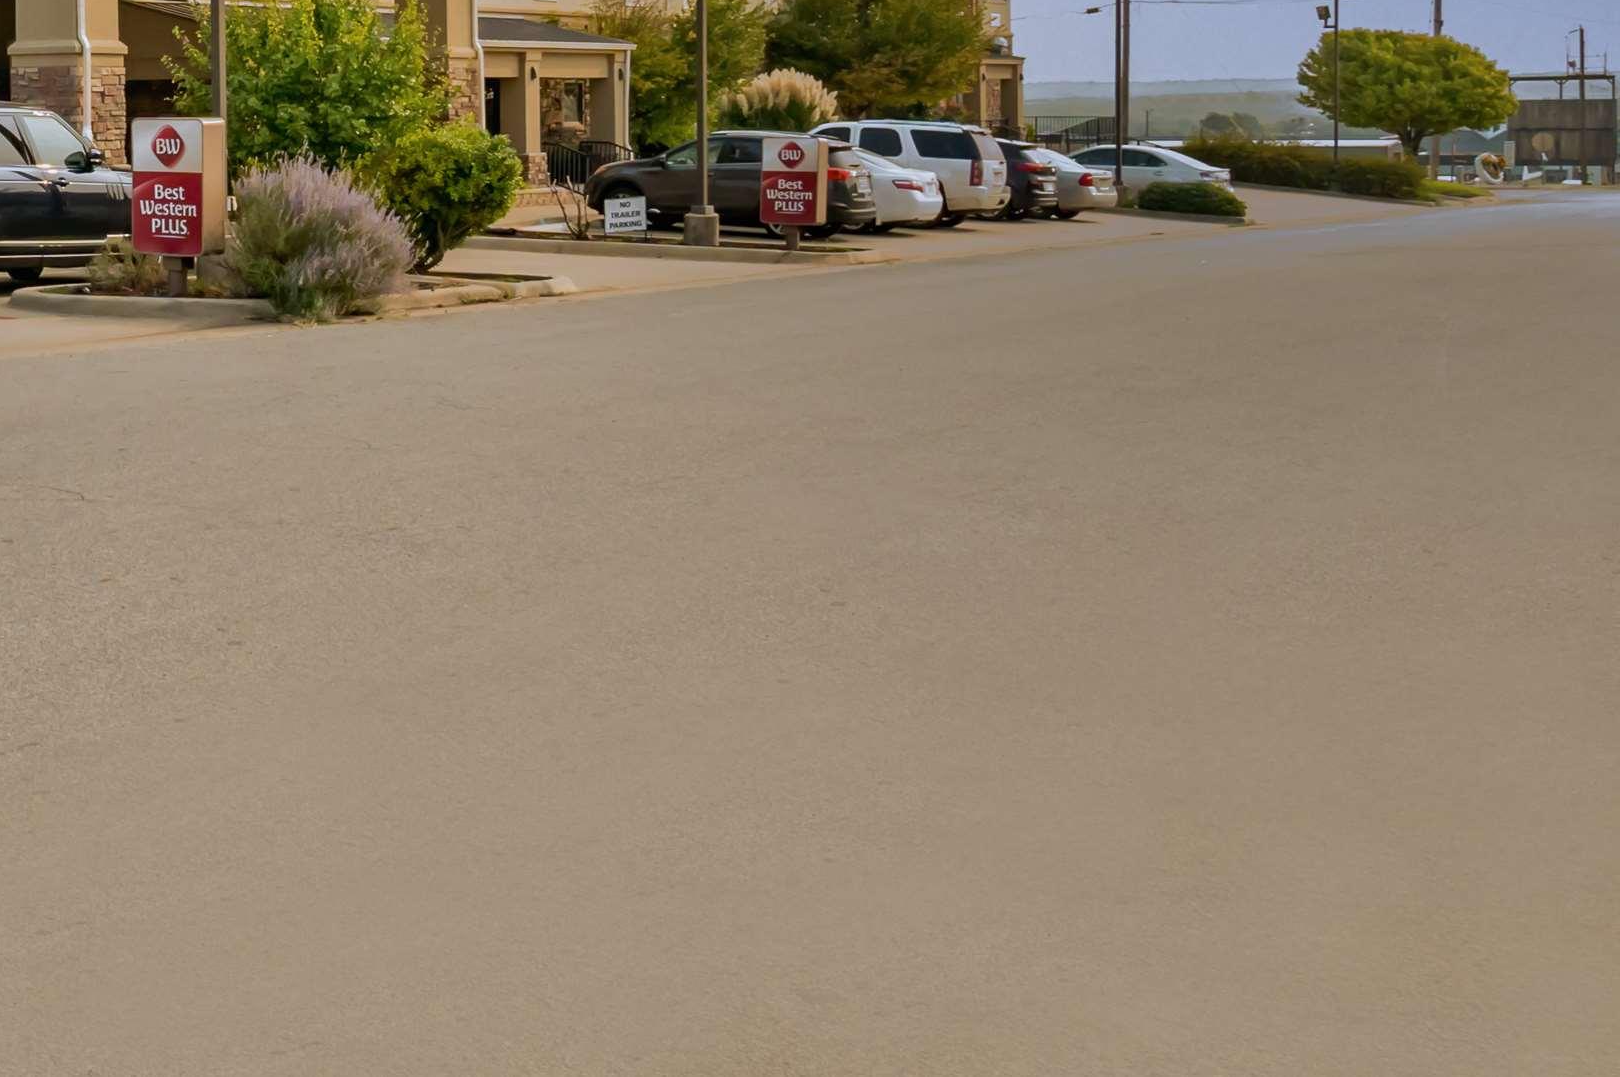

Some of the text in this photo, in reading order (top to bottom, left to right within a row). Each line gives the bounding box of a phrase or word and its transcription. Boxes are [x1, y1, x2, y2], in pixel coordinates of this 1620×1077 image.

[155, 138, 180, 155] BW
[781, 149, 801, 161] BW
[778, 178, 803, 190] Best
[154, 184, 185, 200] Best
[766, 188, 813, 200] Western
[140, 199, 197, 217] Western
[620, 201, 631, 209] NO
[774, 201, 805, 212] PLUS
[151, 218, 188, 235] PLUS
